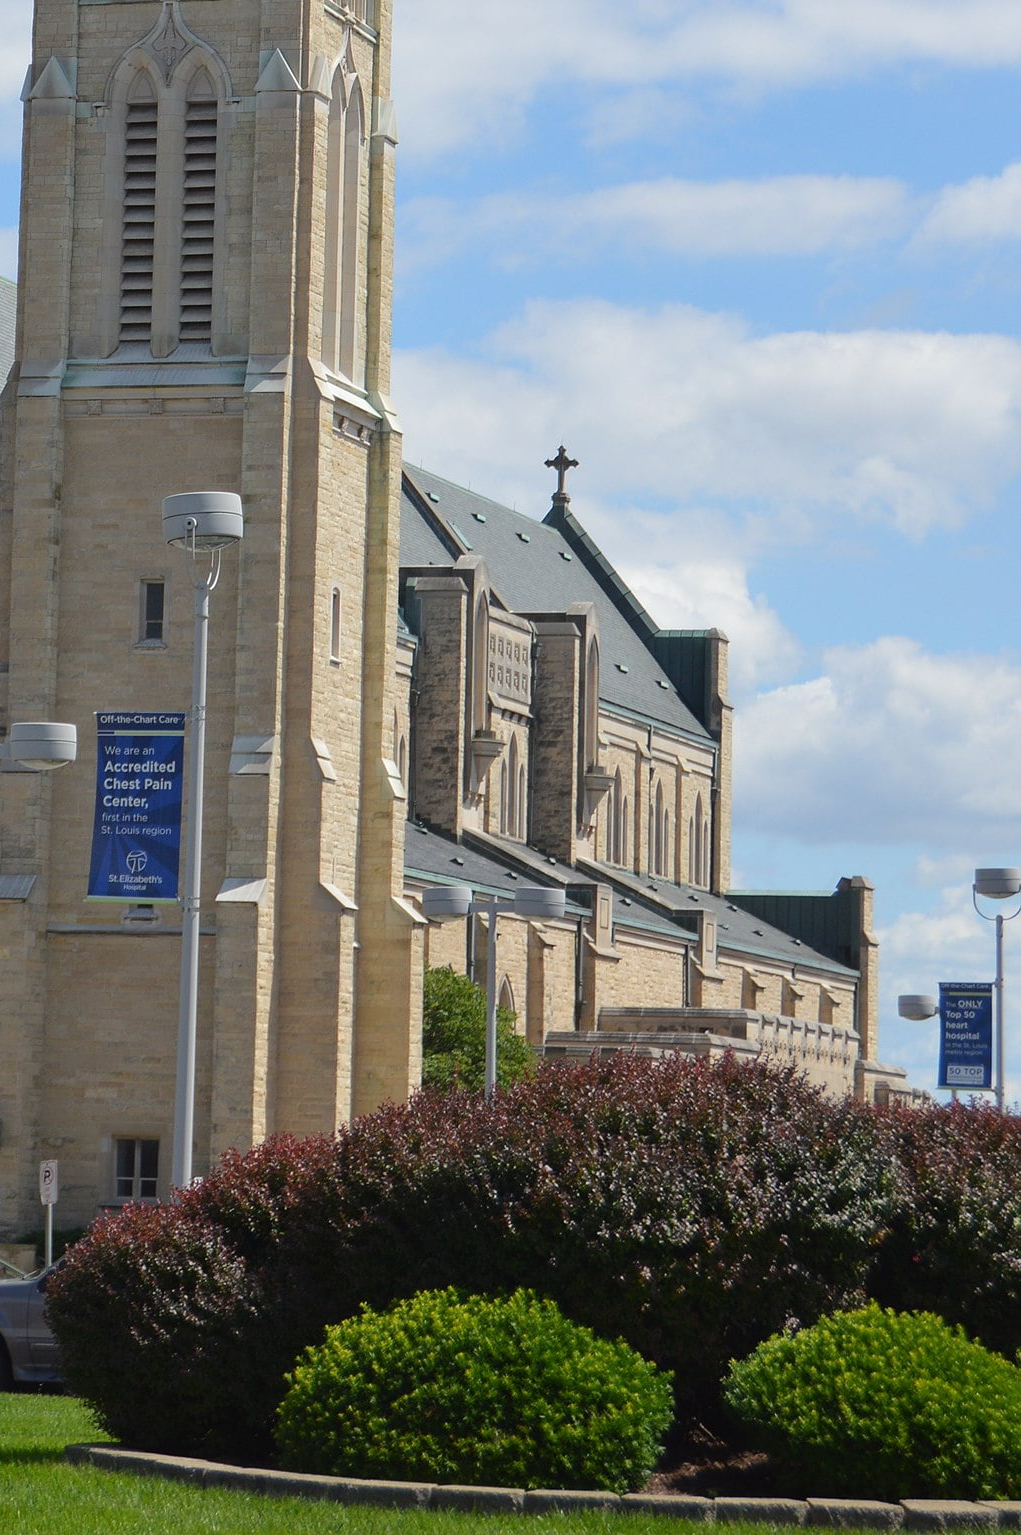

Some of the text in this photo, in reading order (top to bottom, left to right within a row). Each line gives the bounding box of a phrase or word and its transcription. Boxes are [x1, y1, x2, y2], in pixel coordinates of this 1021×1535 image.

[100, 715, 179, 724] Off-the-Chart Care
[104, 746, 155, 755] We are an
[104, 761, 176, 773] Accredited
[103, 778, 172, 790] Chest Pain
[103, 795, 149, 809] Center,
[101, 812, 148, 822] first in the
[101, 825, 172, 837] St. Louis region
[119, 874, 163, 884] Elizabeth's
[958, 1000, 983, 1009] ONLY
[946, 1010, 976, 1020] Top 50
[945, 1021, 968, 1029] heart
[945, 1032, 980, 1041] hospital
[949, 1067, 983, 1076] 50 TOP
